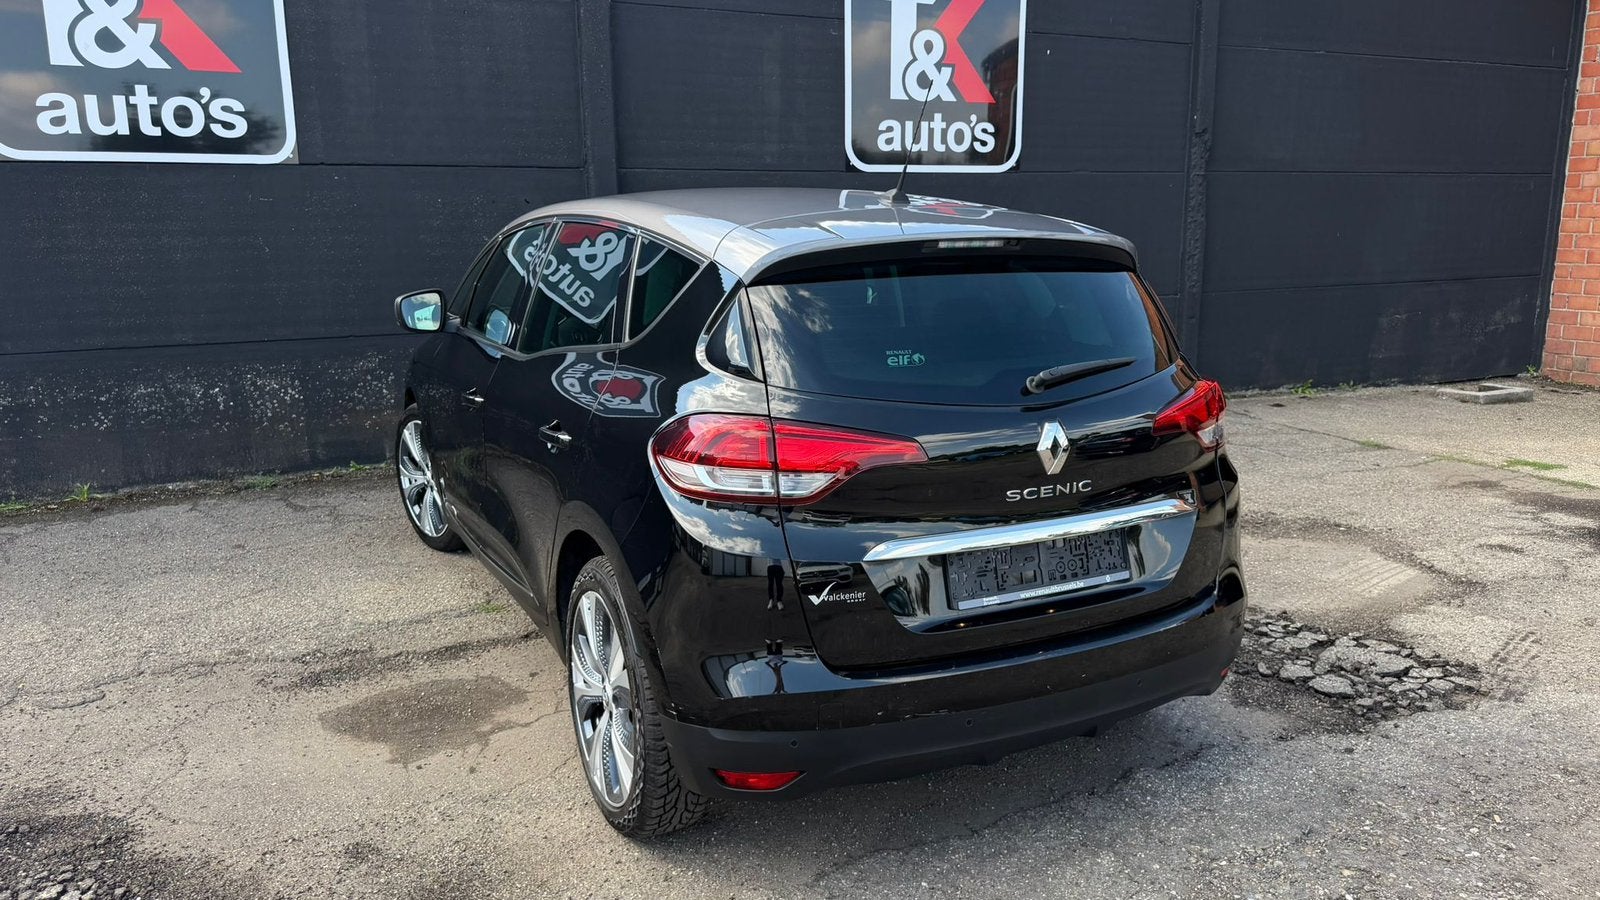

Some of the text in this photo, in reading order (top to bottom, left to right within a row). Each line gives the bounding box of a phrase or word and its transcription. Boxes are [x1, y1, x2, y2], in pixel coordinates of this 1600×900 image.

[35, 84, 248, 138] auto's
[877, 113, 996, 153] auto's
[887, 355, 911, 366] elf
[1006, 480, 1092, 502] SCENIC
